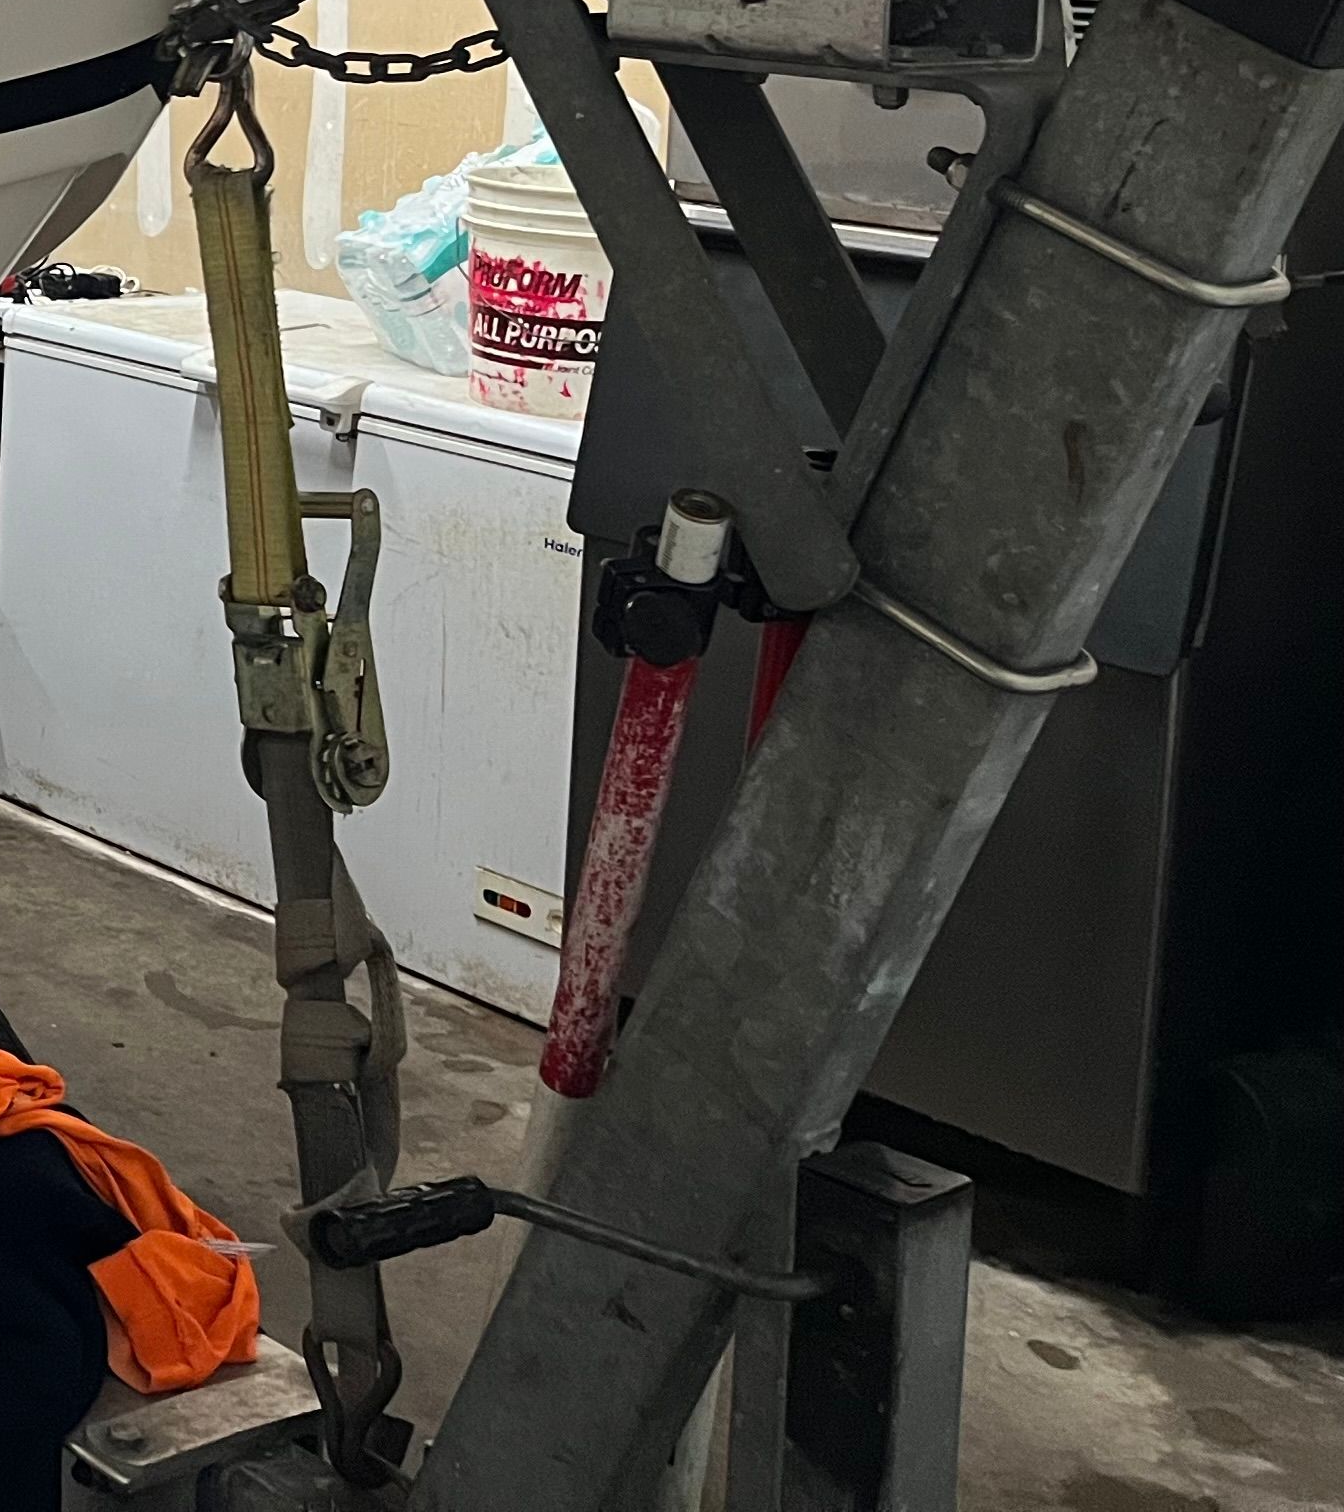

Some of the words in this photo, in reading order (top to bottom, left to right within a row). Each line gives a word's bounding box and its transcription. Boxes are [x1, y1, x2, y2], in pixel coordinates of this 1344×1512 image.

[473, 254, 582, 299] PROFORM
[473, 313, 501, 343] ALL
[504, 321, 602, 355] PURPO
[544, 537, 583, 557] Haier
